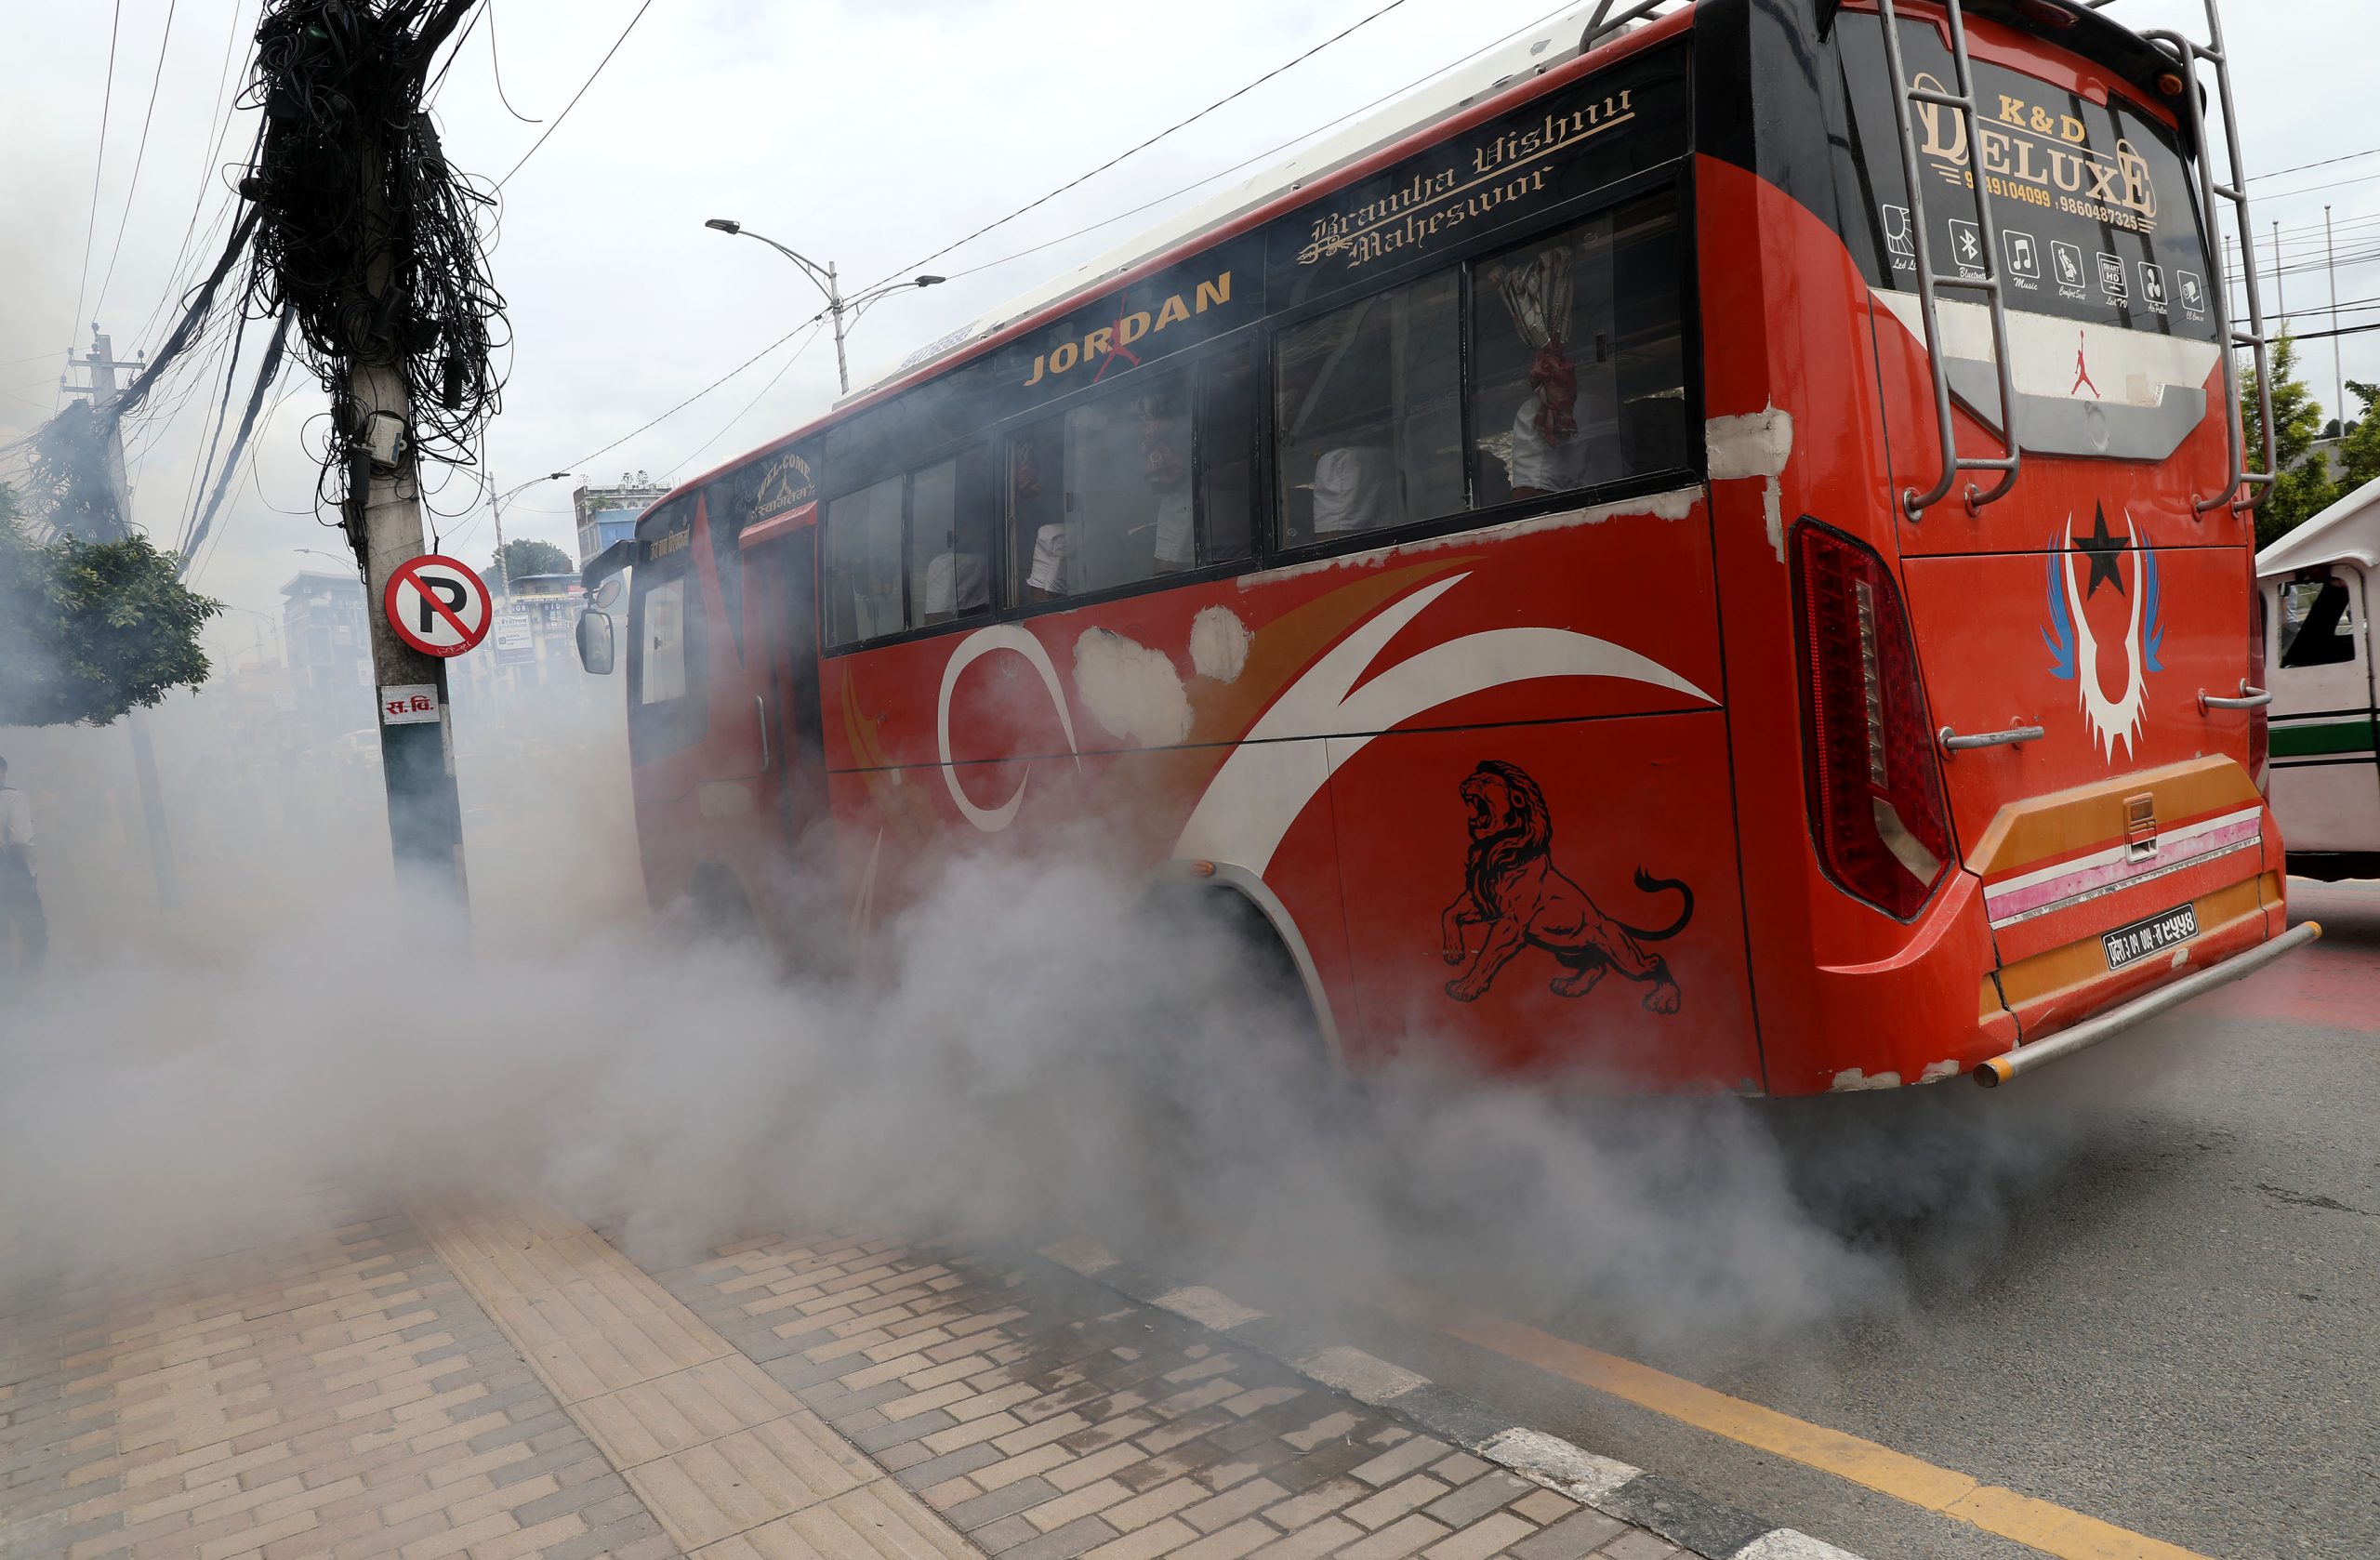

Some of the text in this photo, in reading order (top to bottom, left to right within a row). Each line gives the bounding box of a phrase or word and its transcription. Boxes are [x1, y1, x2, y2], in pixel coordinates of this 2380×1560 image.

[1999, 94, 2086, 143] K & D
[1914, 73, 2157, 218] DELUXE
[1964, 170, 2051, 207] 949104099
[2013, 277, 2039, 291] Music
[2102, 262, 2120, 274] SMART
[2106, 271, 2120, 283] HD
[1023, 271, 1231, 387] JORDAN
[419, 575, 468, 634] P
